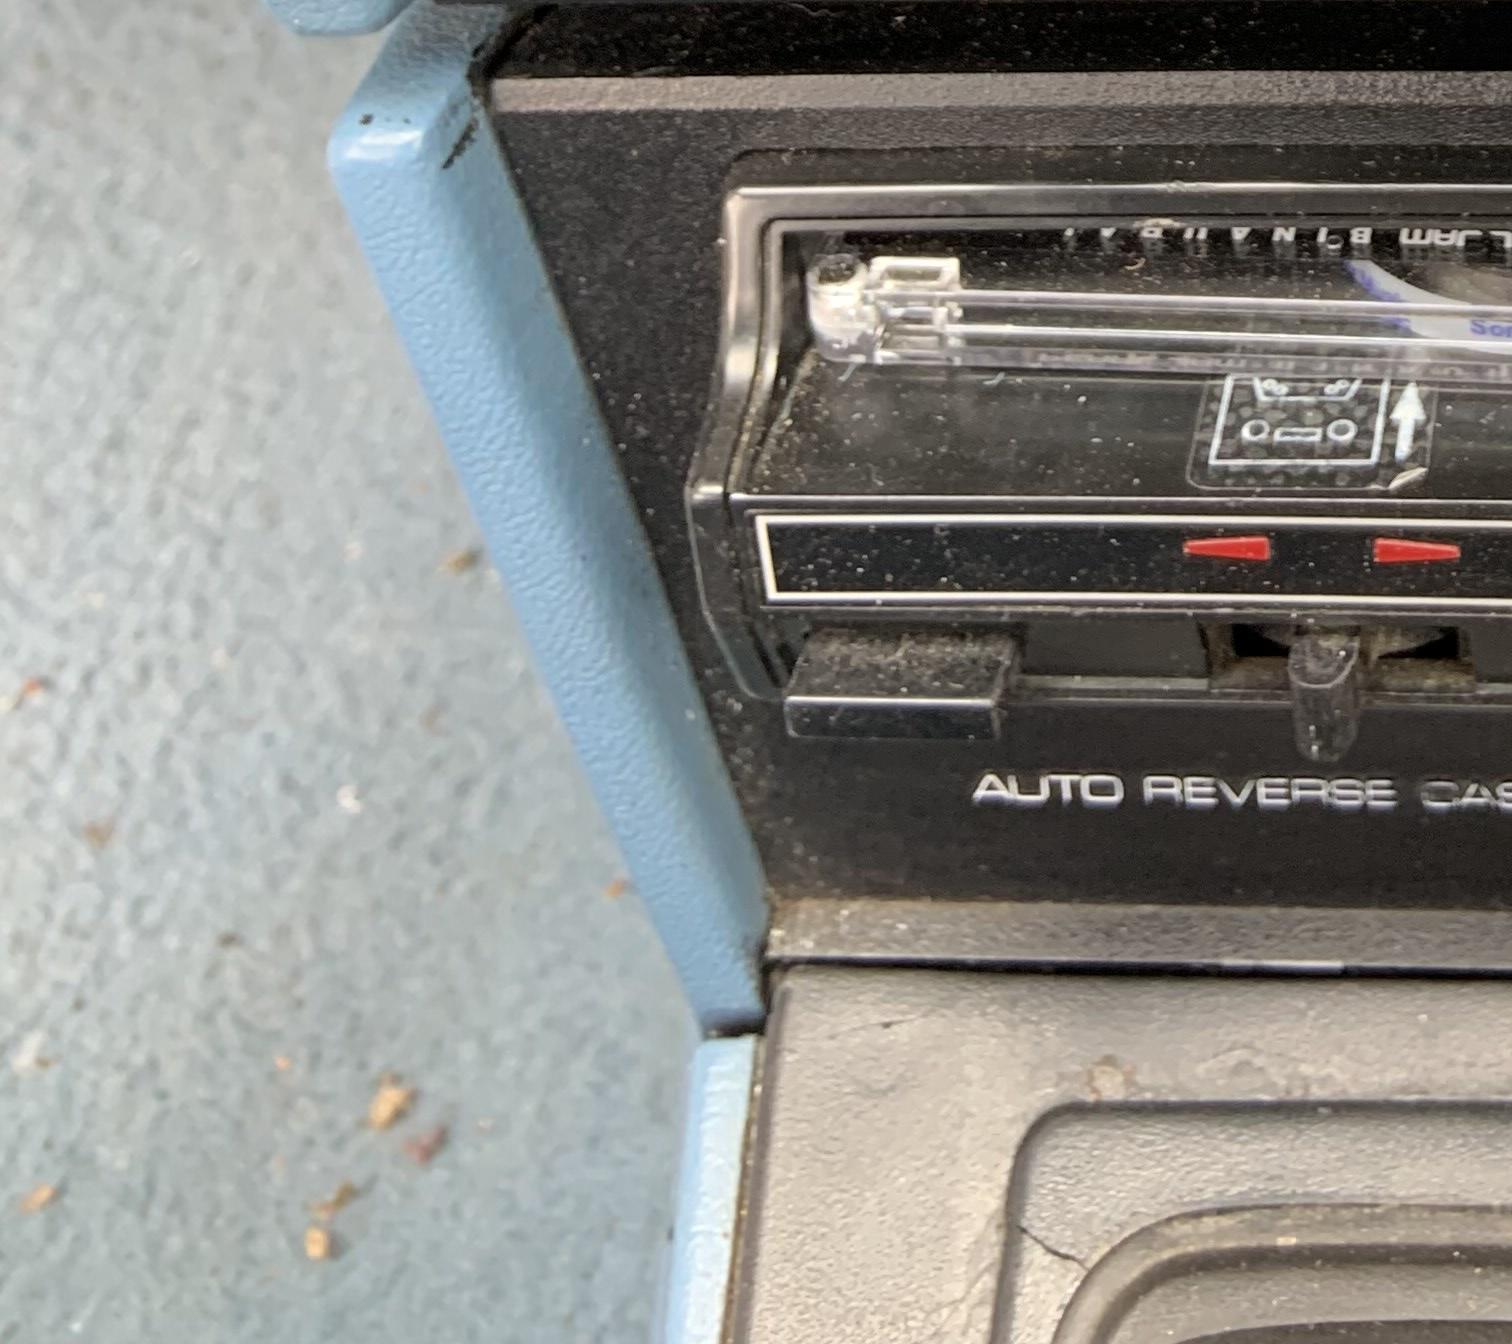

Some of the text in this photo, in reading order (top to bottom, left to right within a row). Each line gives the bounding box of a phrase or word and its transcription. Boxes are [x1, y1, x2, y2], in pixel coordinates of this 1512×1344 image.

[1400, 227, 1483, 246] JAM
[973, 774, 1124, 806] AUTO
[1144, 775, 1398, 808] REVERSE
